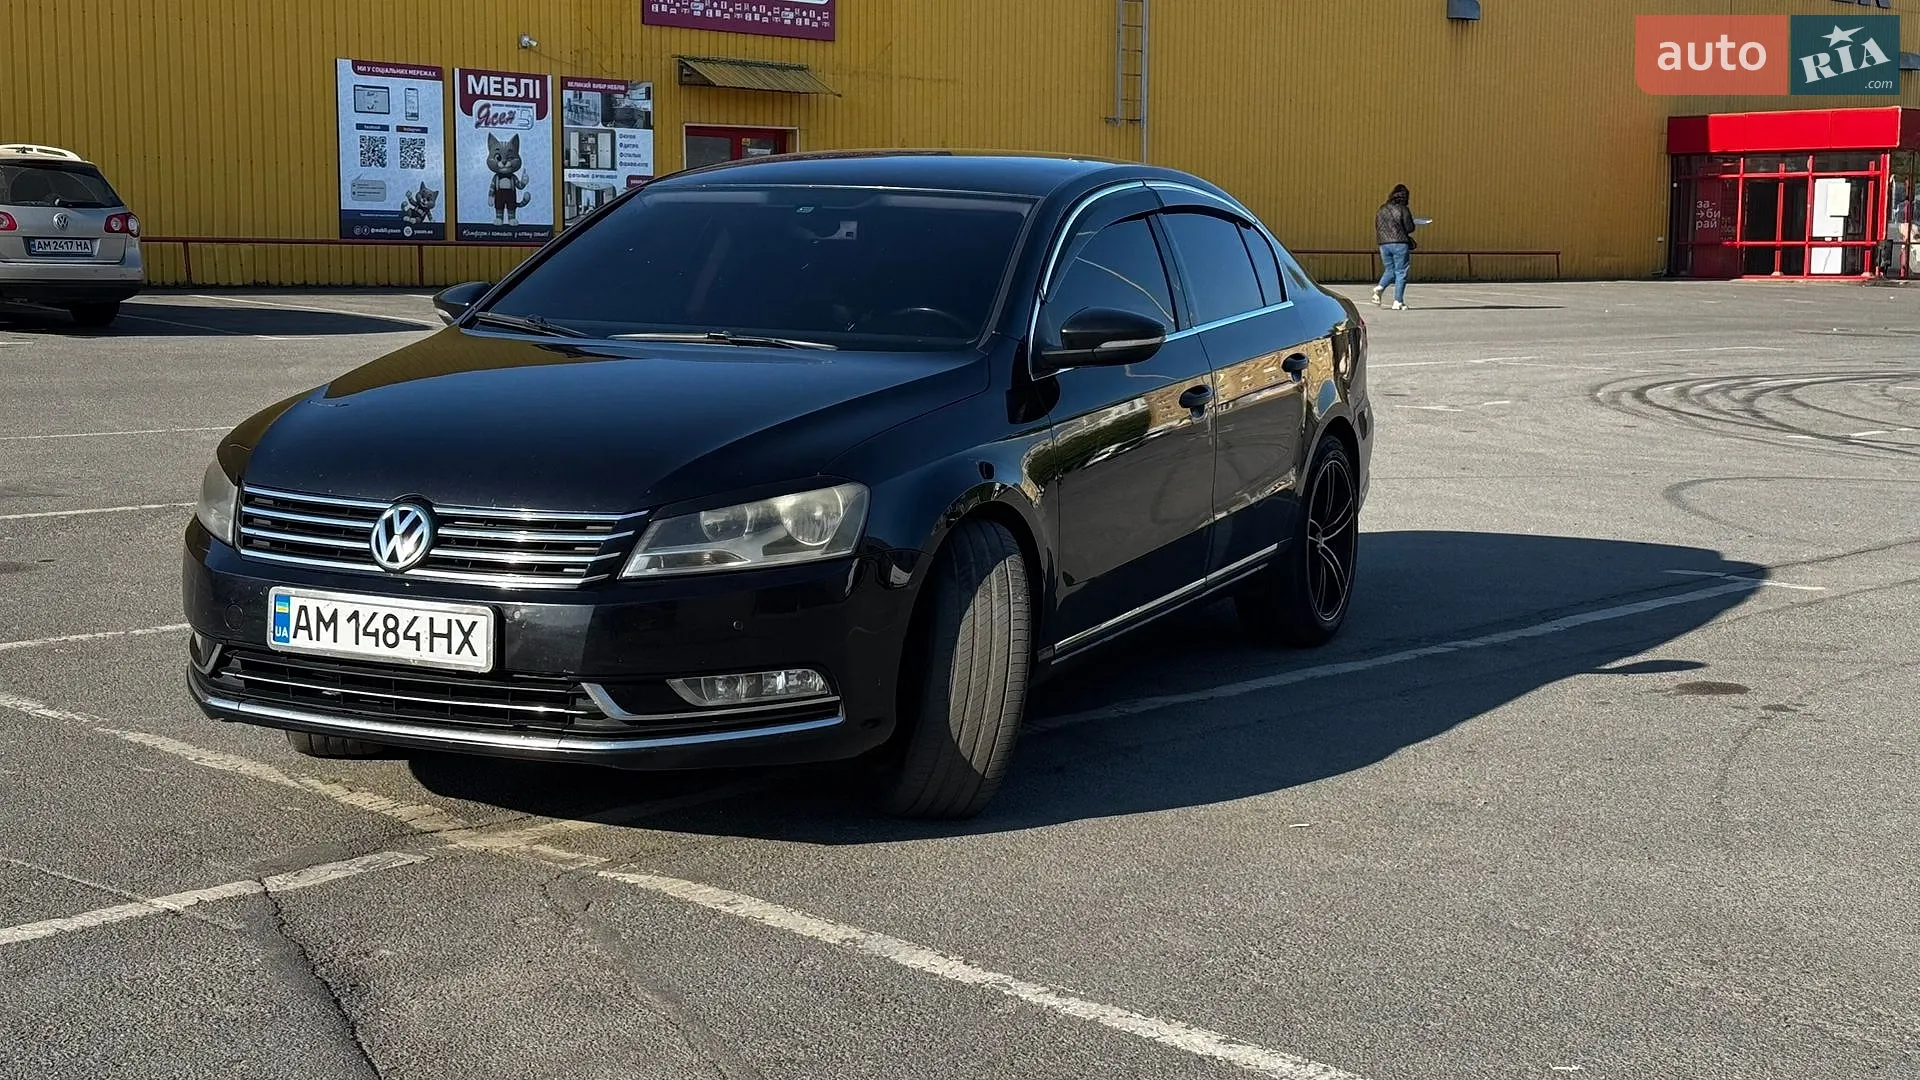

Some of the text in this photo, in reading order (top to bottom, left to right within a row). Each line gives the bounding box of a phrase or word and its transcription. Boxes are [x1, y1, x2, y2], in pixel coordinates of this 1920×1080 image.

[371, 66, 408, 75] СОЦІАЛЬНИХ
[408, 68, 437, 77] МЕРЕЖАХ
[467, 74, 541, 99] МЕБЛІ
[475, 102, 517, 129] Ясен
[1706, 208, 1721, 219] би
[1696, 218, 1718, 230] рай
[36, 240, 52, 251] AM
[53, 240, 74, 251] 2417
[75, 241, 90, 252] HA
[275, 604, 478, 657] UA AM 1484 HX
